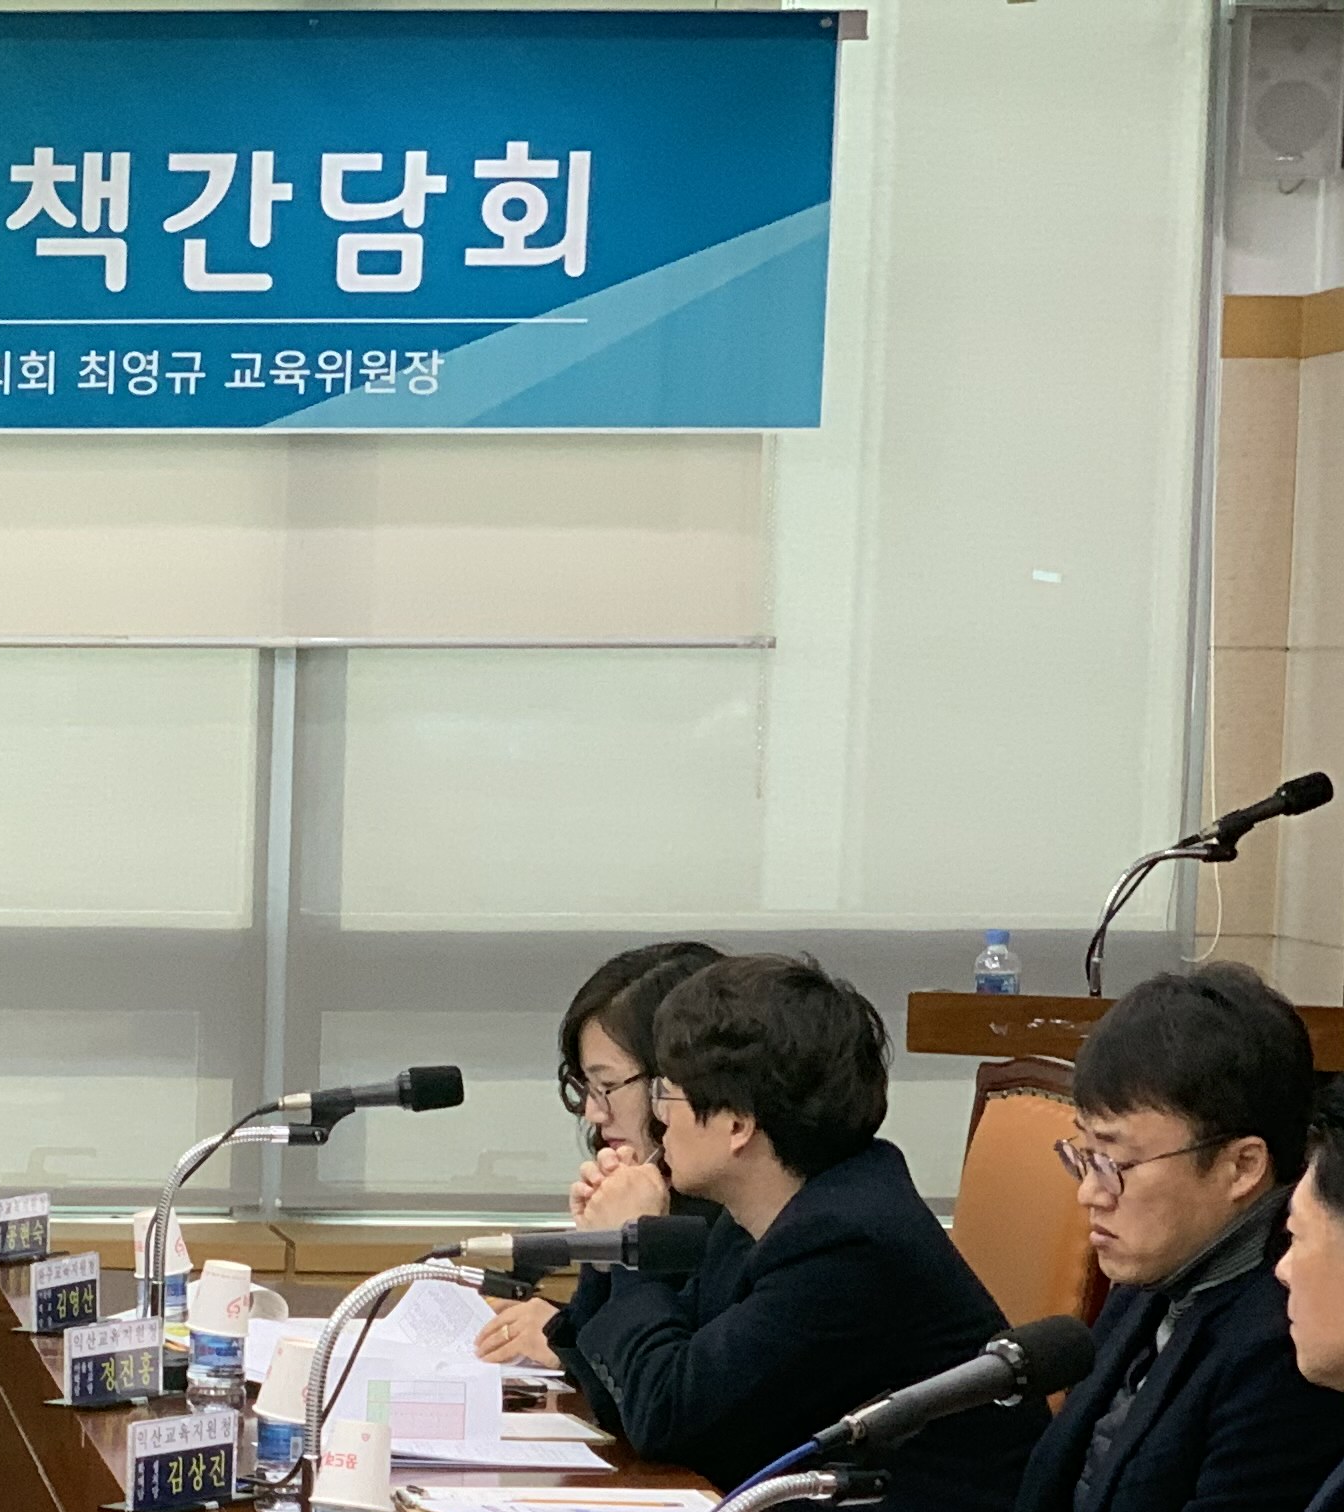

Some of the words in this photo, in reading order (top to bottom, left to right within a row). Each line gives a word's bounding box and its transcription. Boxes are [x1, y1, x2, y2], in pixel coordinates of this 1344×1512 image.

[78, 351, 206, 395] 최영규
[225, 351, 445, 396] 교육위원장
[56, 1283, 94, 1319] 김영산
[73, 1323, 157, 1352] 익산교육지원청
[100, 1352, 154, 1391] 정진홍
[137, 1416, 231, 1449] 익산교육지원청
[167, 1450, 226, 1495] 김상진
